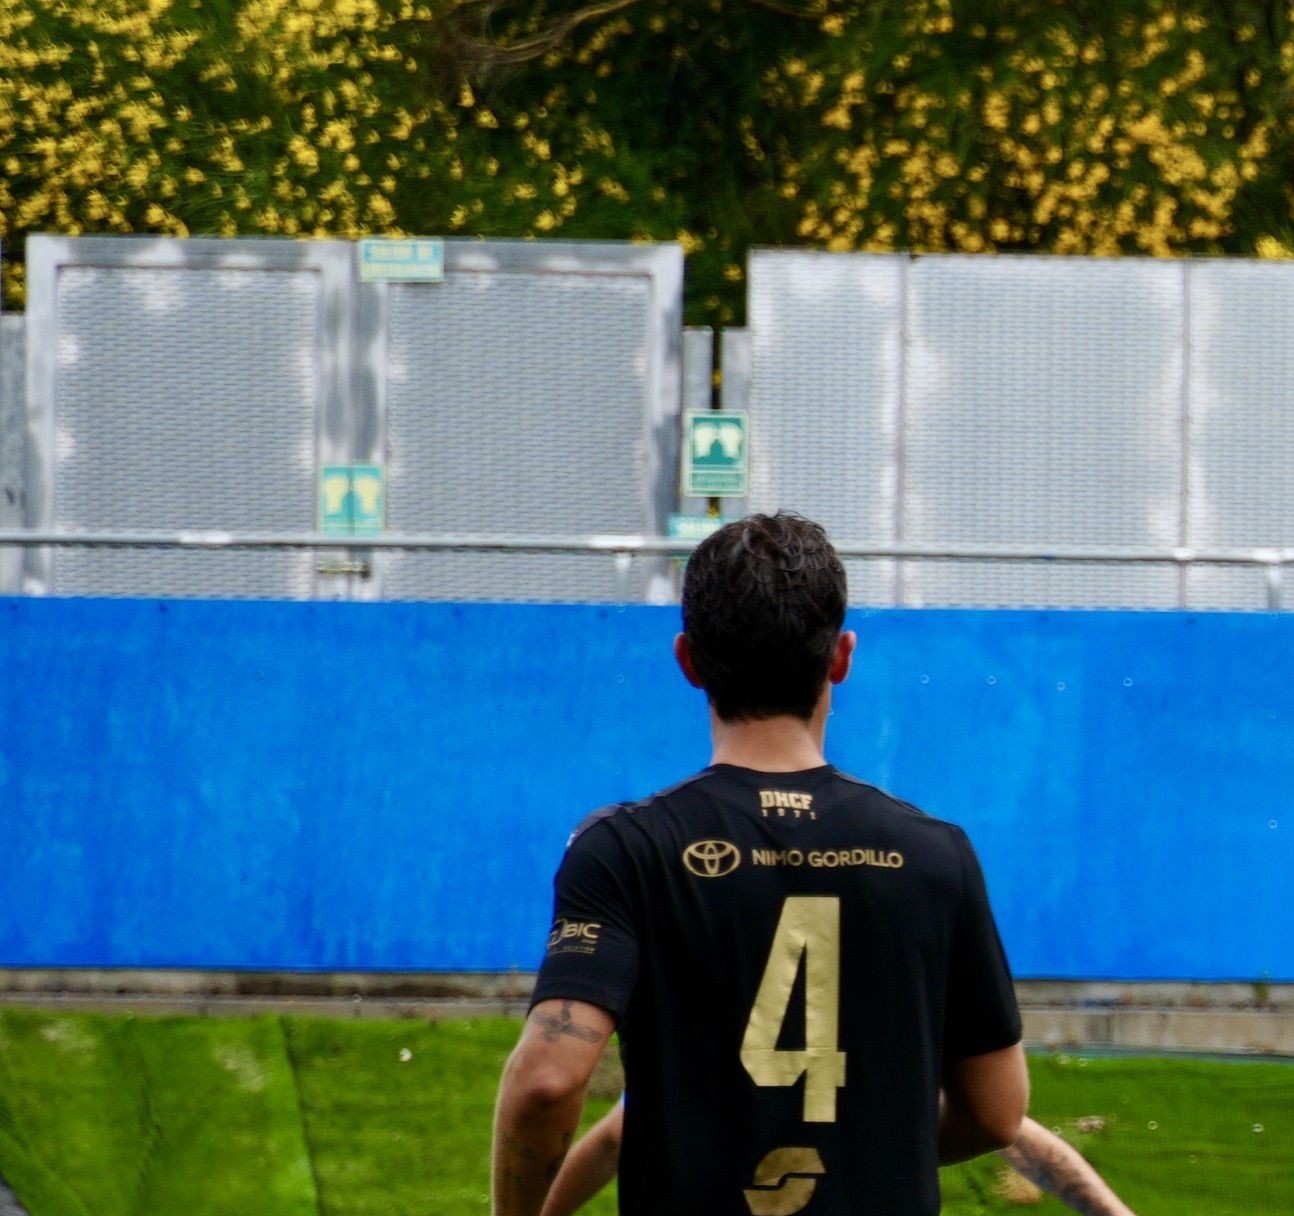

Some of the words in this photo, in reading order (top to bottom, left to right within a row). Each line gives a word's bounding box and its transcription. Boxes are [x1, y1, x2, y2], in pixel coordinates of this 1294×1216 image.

[752, 849, 803, 866] NIMO
[808, 849, 904, 868] GORDILLO
[740, 896, 847, 1122] 4
